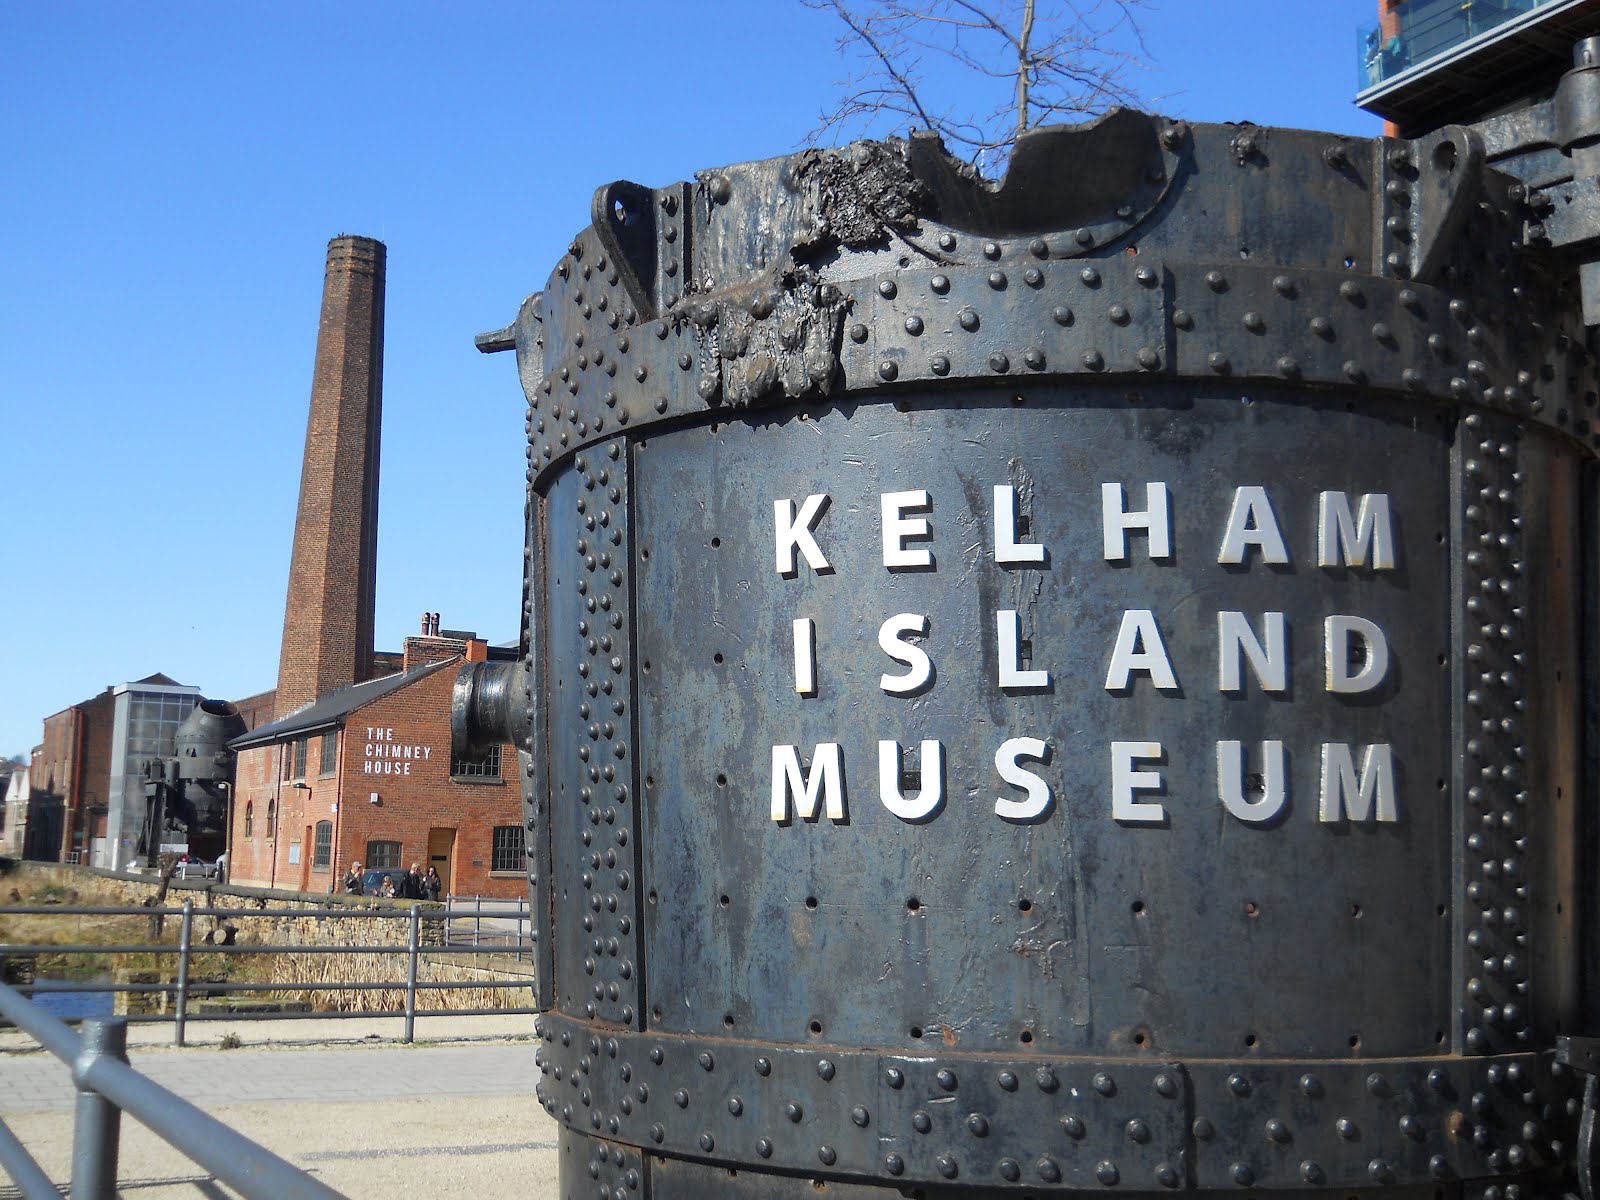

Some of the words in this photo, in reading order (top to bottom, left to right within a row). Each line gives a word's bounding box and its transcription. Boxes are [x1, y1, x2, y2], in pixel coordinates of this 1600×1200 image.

[774, 482, 1396, 574] KELHAM
[792, 609, 1390, 694] ISLAND
[365, 743, 431, 760] CHIMNEY
[367, 727, 393, 741] THE
[364, 760, 411, 775] HOUSE
[770, 736, 1397, 822] MUSEUM
